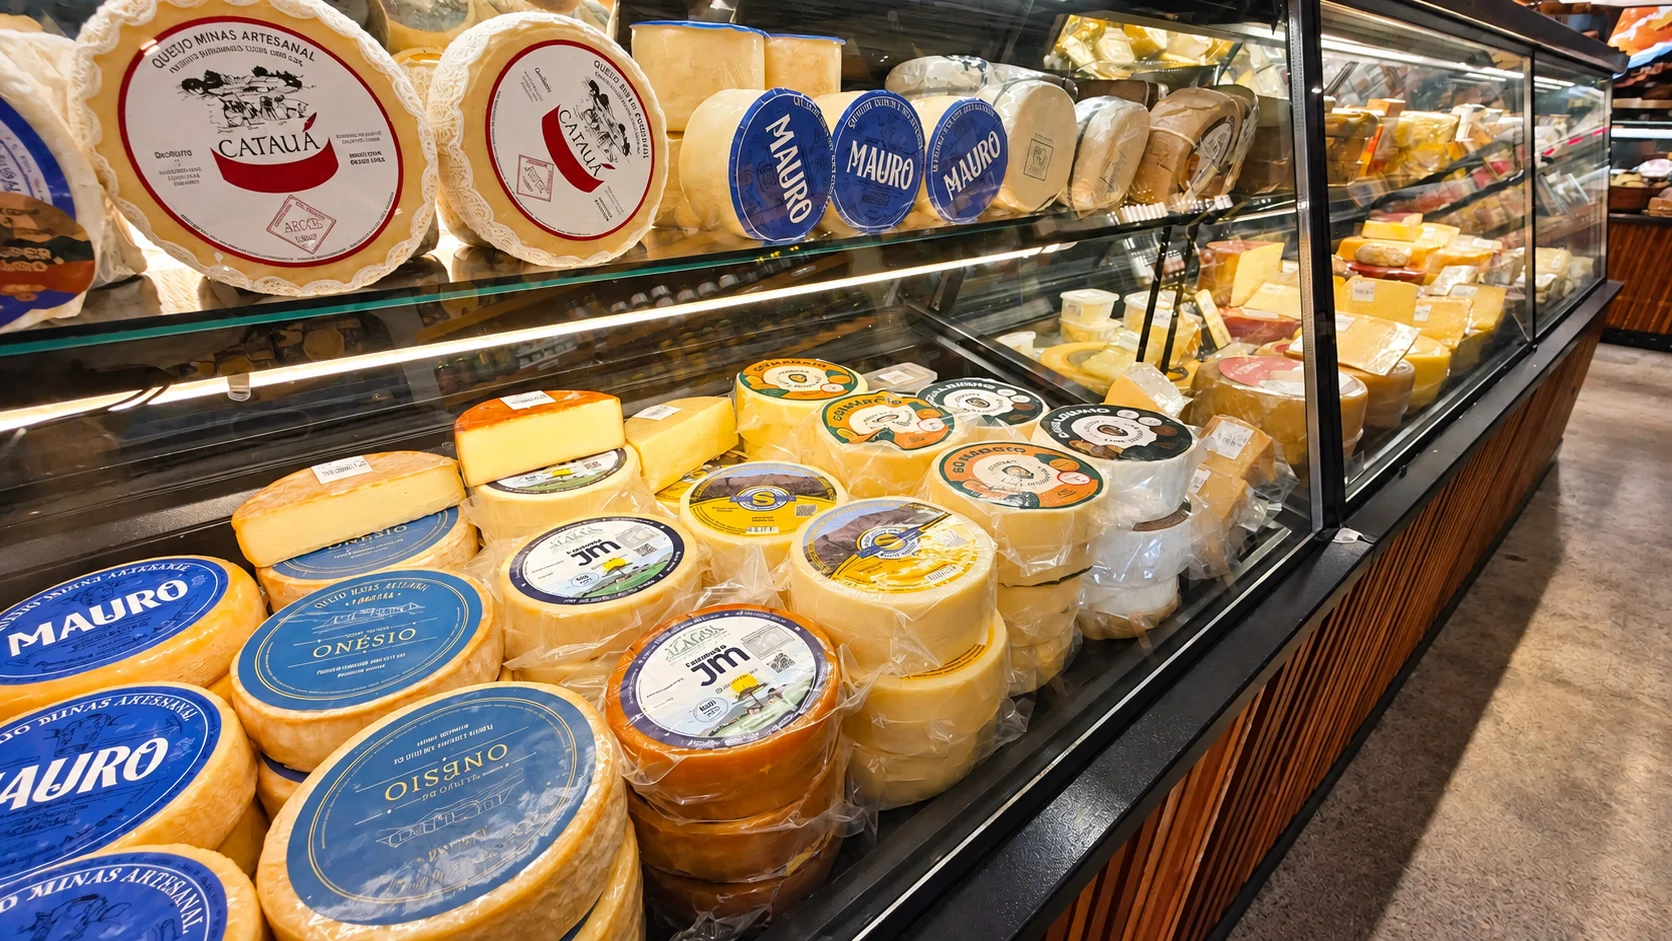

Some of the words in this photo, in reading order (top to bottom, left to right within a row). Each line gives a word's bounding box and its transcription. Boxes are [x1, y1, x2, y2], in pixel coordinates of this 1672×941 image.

[152, 38, 193, 69] QUEIJO
[194, 29, 237, 44] MINAS
[242, 31, 316, 62] ARTESANAL
[765, 113, 813, 224] MAURO
[846, 140, 914, 190] MAURO
[943, 130, 1001, 201] MAURO
[7, 579, 189, 657] MAURO
[312, 627, 417, 658] ONÉSIO
[0, 737, 169, 811] AURO
[27, 867, 123, 901] MINAS
